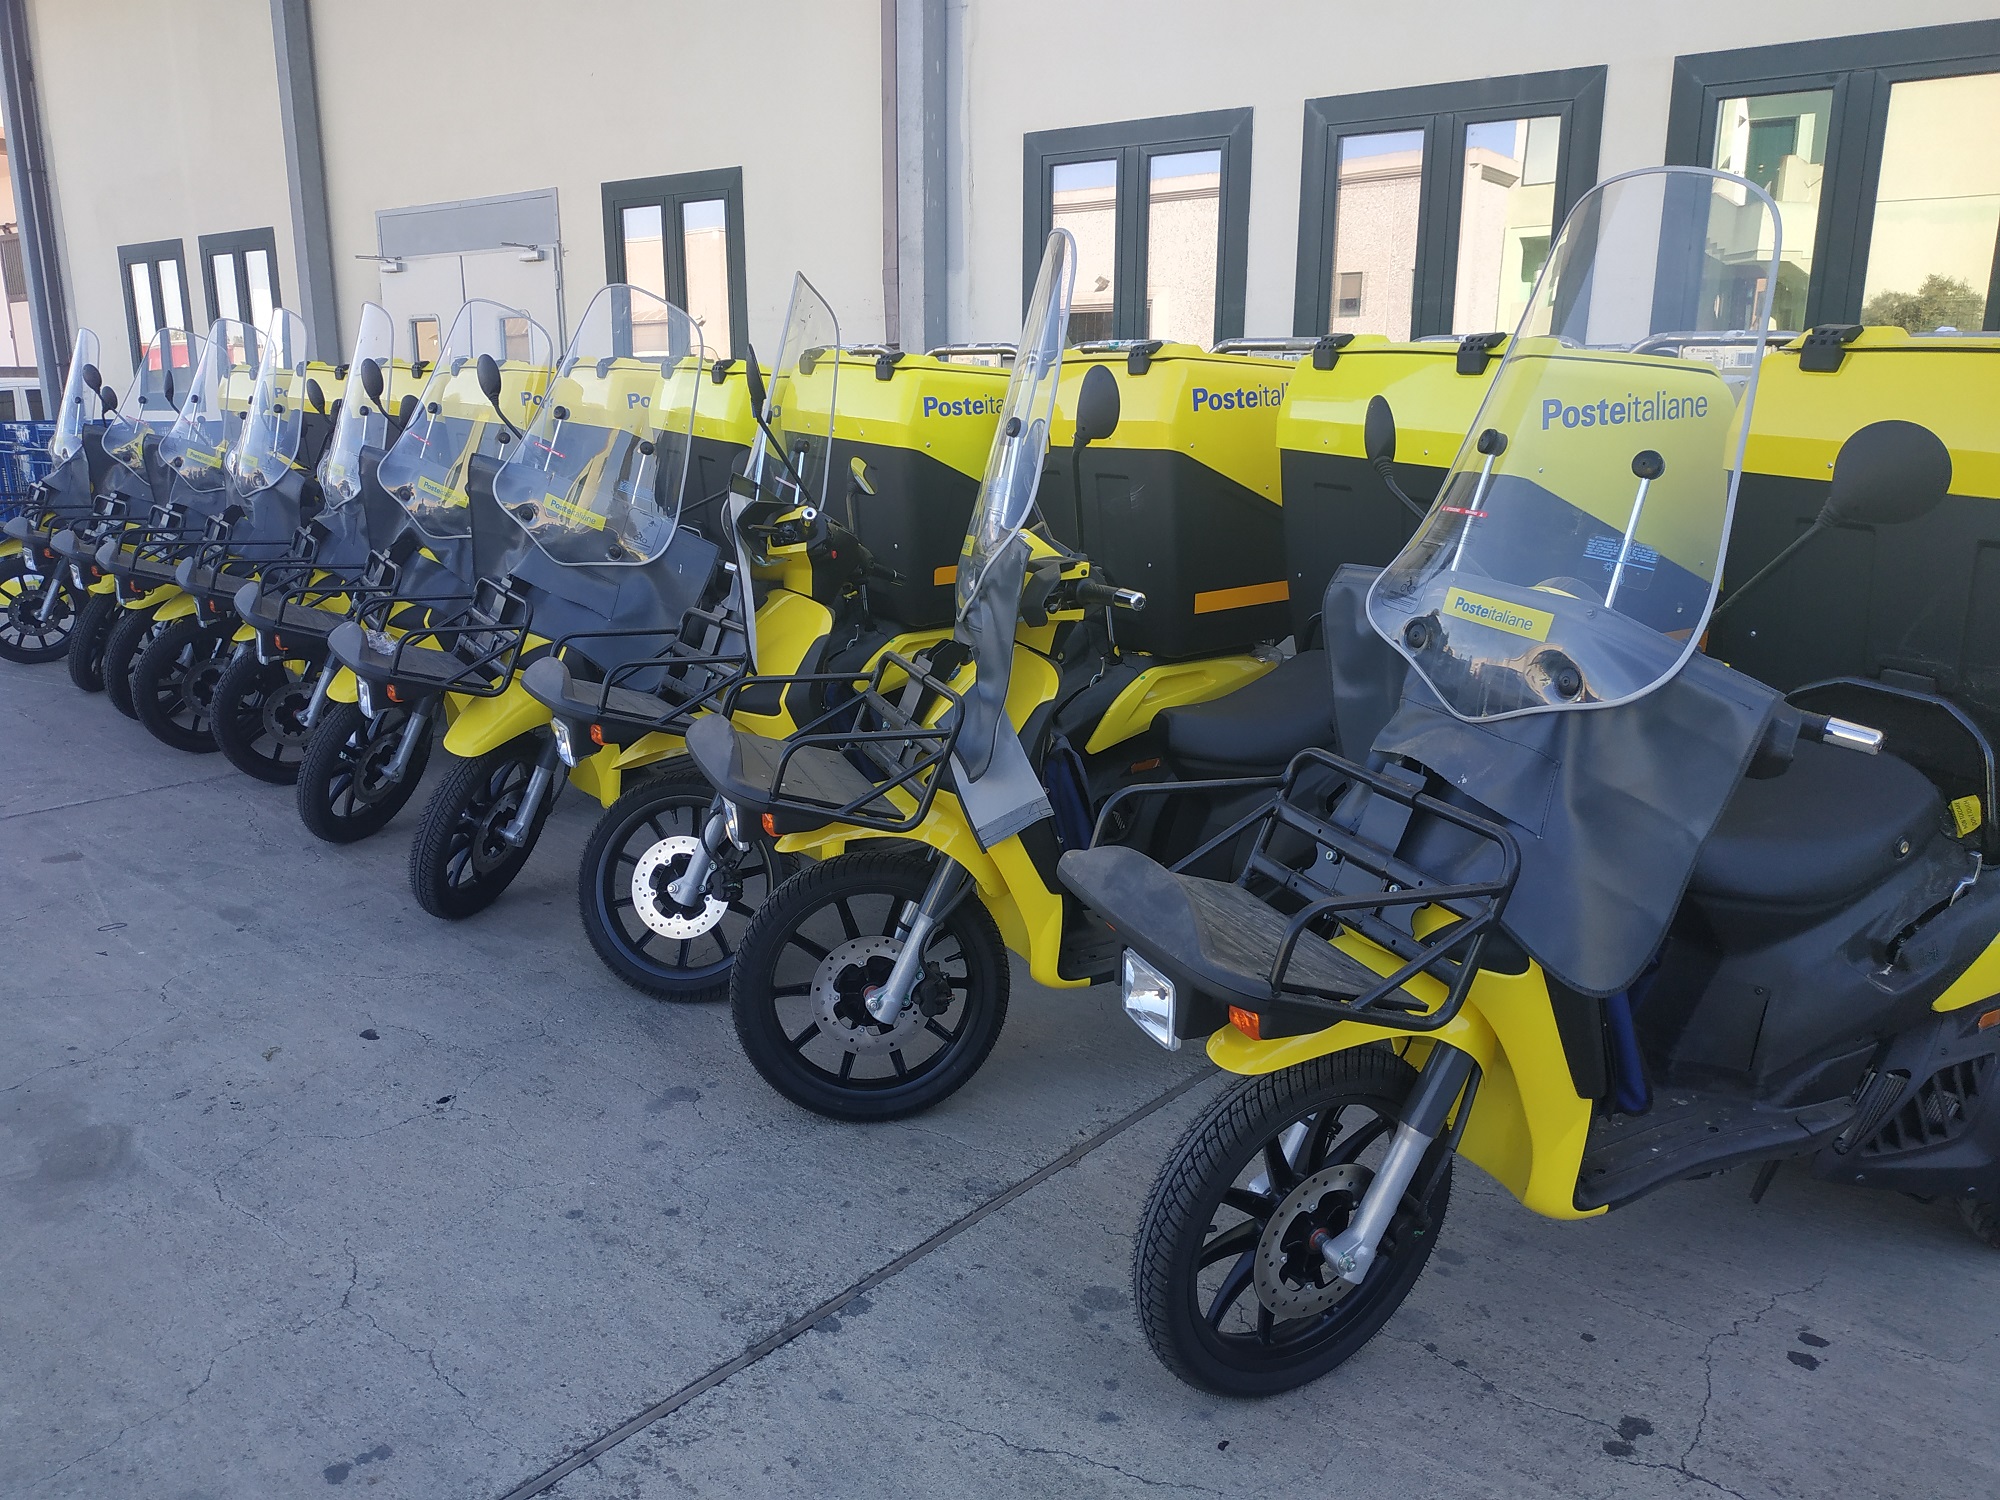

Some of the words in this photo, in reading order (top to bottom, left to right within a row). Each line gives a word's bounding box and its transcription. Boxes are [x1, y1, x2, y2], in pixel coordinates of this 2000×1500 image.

[1192, 382, 1289, 412] Posteital
[1541, 390, 1708, 431] Posteitaliane
[1454, 596, 1533, 631] Posteitaliane
